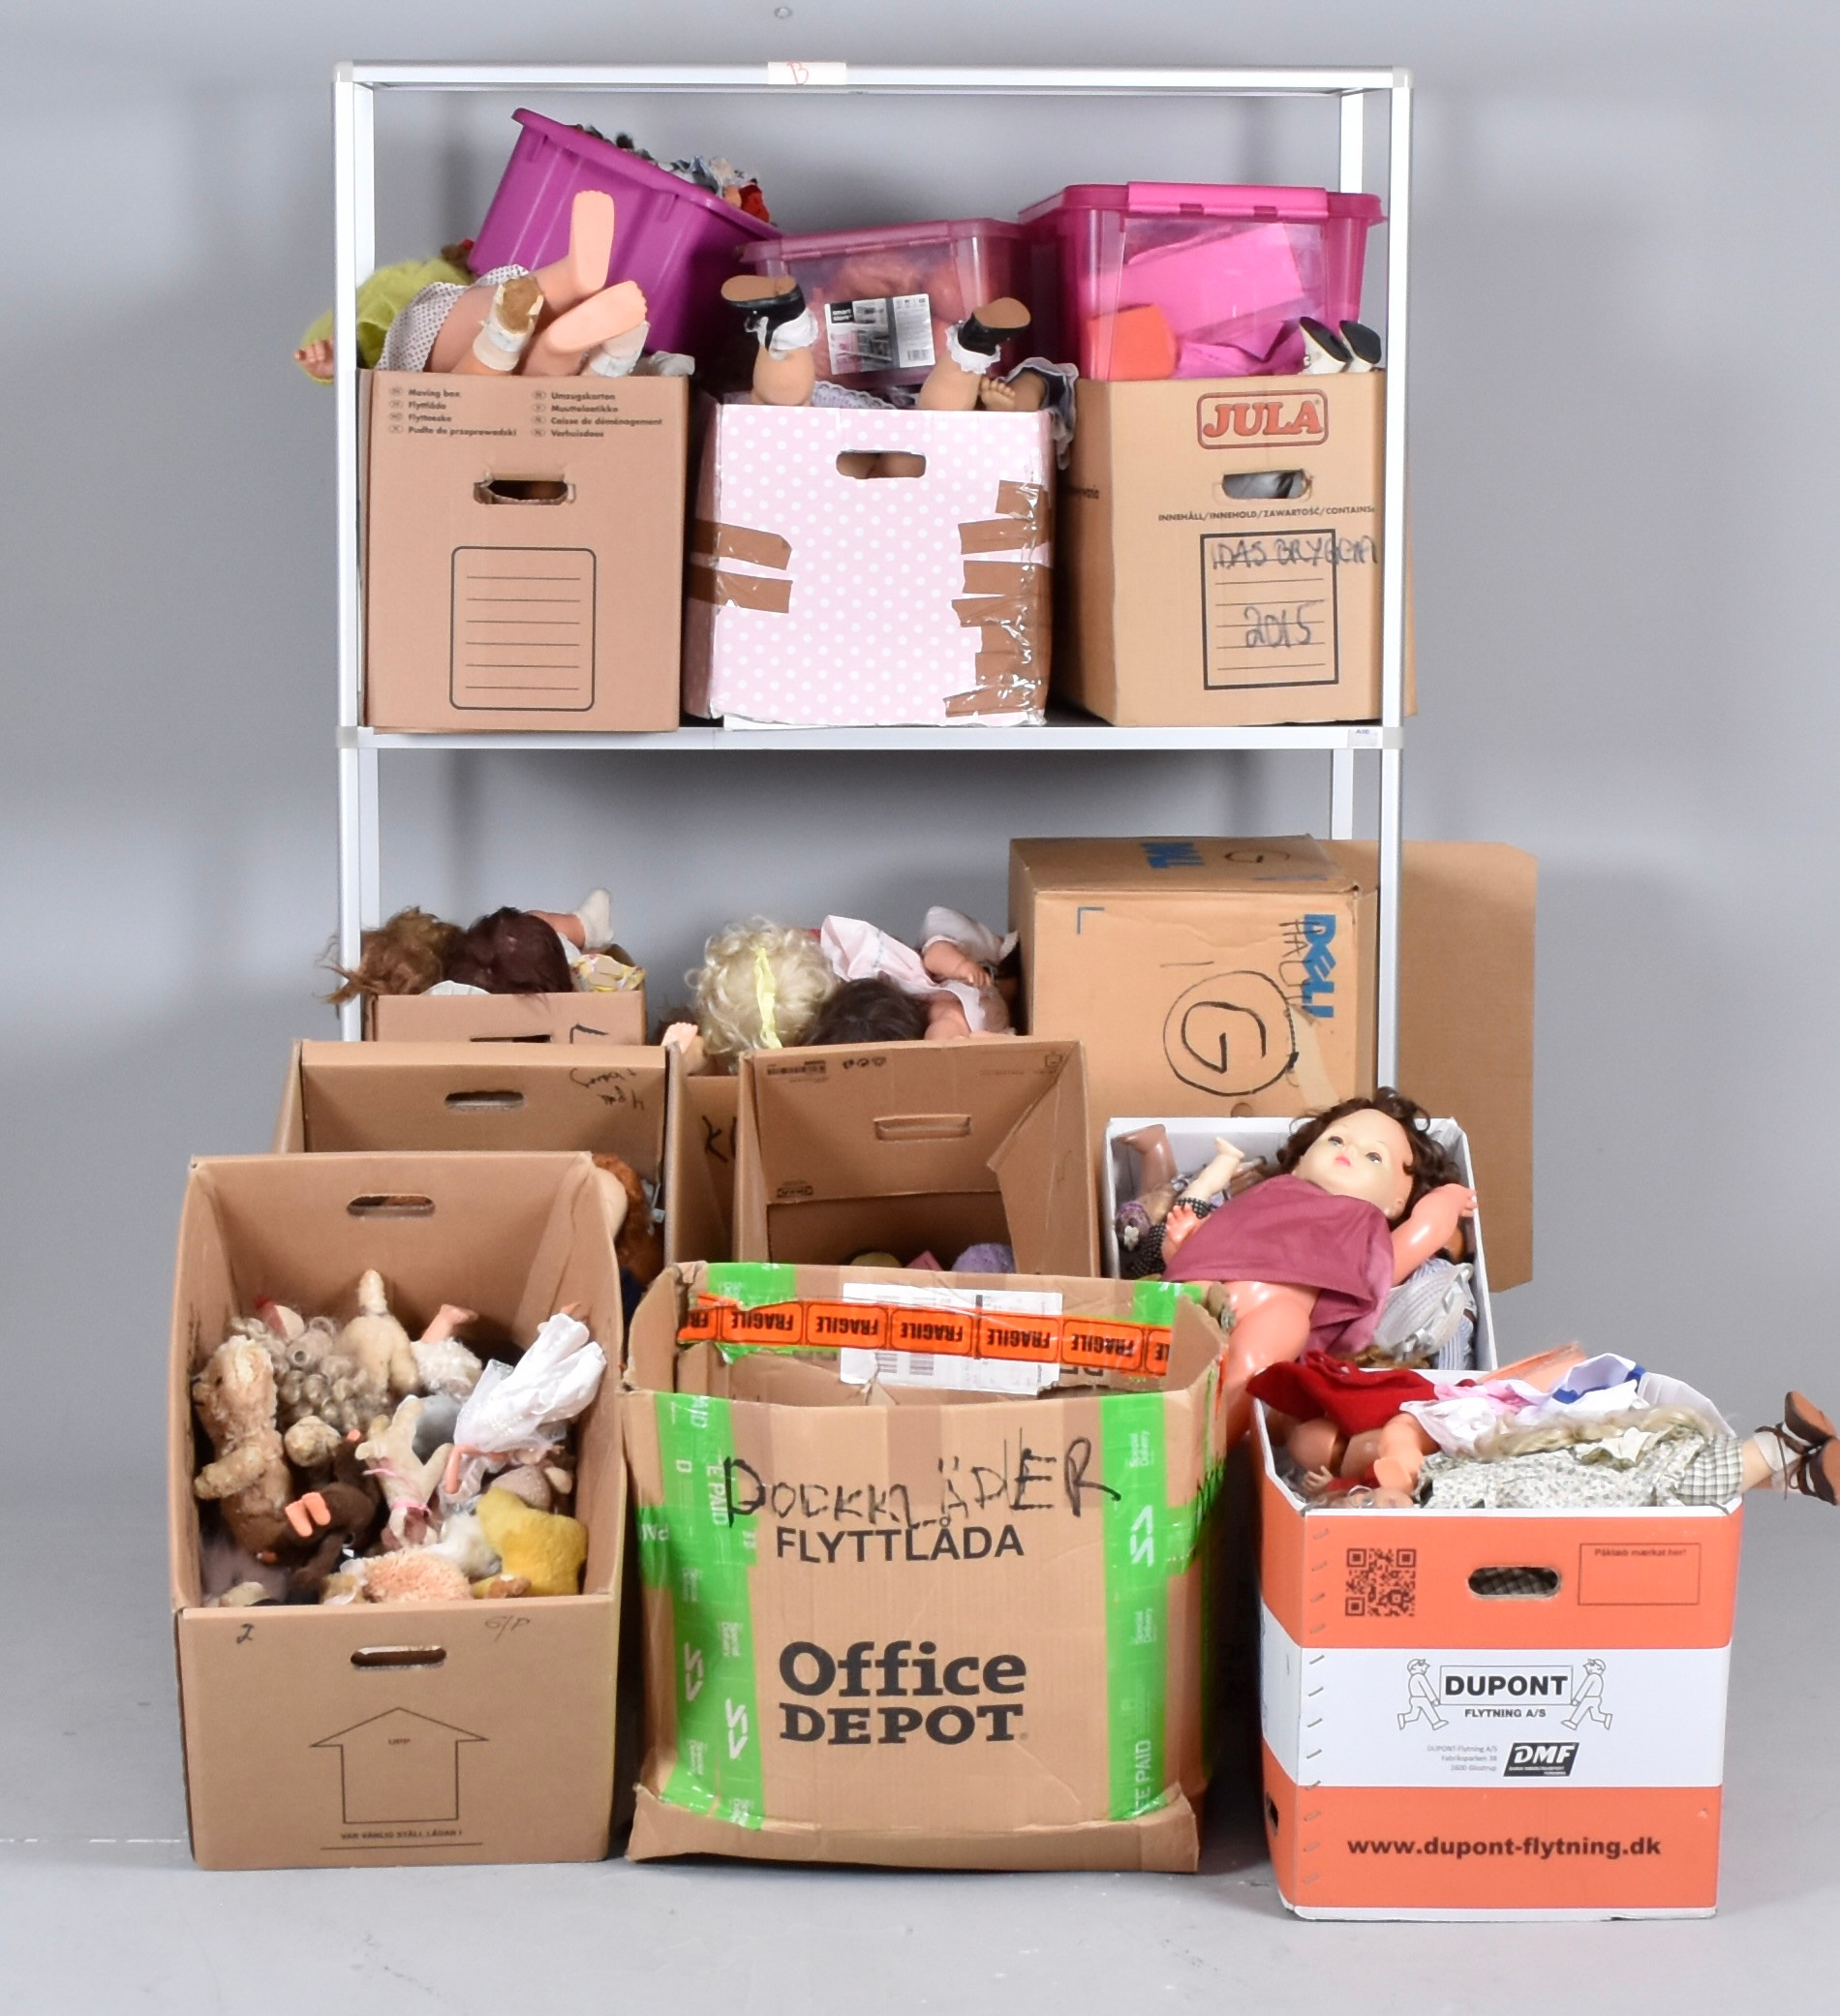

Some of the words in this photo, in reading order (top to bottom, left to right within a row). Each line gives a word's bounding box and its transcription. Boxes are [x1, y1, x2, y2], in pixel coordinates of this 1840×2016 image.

[409, 389, 441, 398] Moving
[1202, 399, 1324, 439] JULA
[1242, 601, 1322, 649] 2015
[1303, 914, 1336, 1018] DELL
[731, 1310, 793, 1331] FRAGILE
[816, 1315, 879, 1336] FRAGILE
[901, 1322, 964, 1343] FRAGILE
[986, 1327, 1052, 1350] FRAGILE
[1070, 1333, 1134, 1358] FRAGILE
[776, 1515, 1025, 1564] FLYTTLÅDA
[779, 1639, 1027, 1698] Office
[1444, 1674, 1569, 1696] DUPONT
[779, 1701, 1025, 1746] DEPOT
[1464, 1708, 1522, 1719] FLYTNING
[1525, 1708, 1547, 1719] A/S
[1135, 1739, 1151, 1784] PAID
[1513, 1745, 1577, 1764] DMF
[1347, 1836, 1662, 1860] www.dupont-flytning.dk
